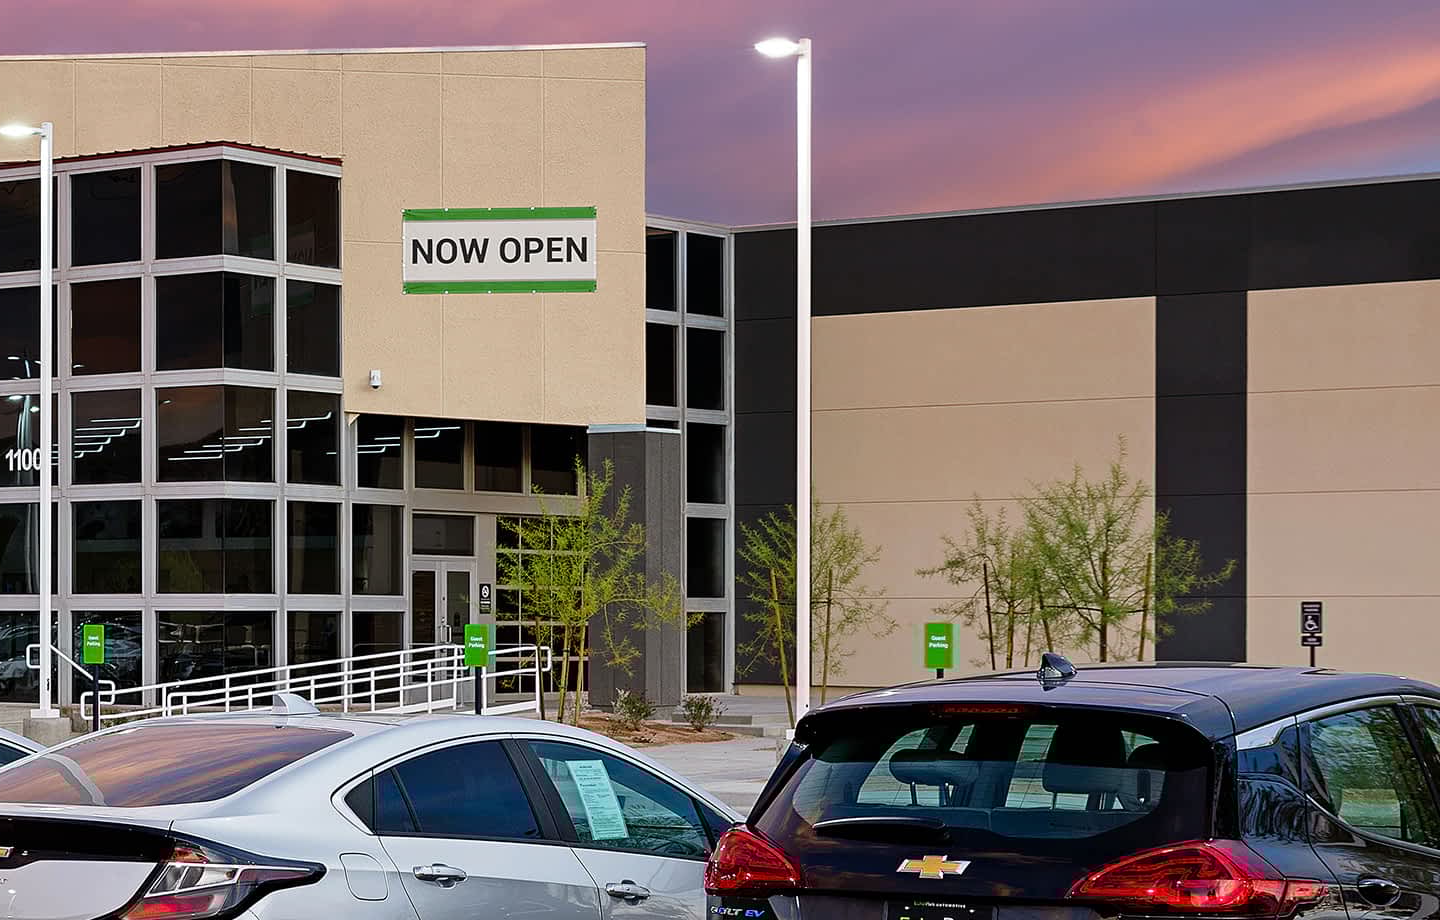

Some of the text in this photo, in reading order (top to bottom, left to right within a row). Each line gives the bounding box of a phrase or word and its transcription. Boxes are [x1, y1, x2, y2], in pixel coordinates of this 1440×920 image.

[411, 236, 588, 265] NOW OPEN
[5, 448, 41, 471] 1100
[745, 909, 765, 917] EV
